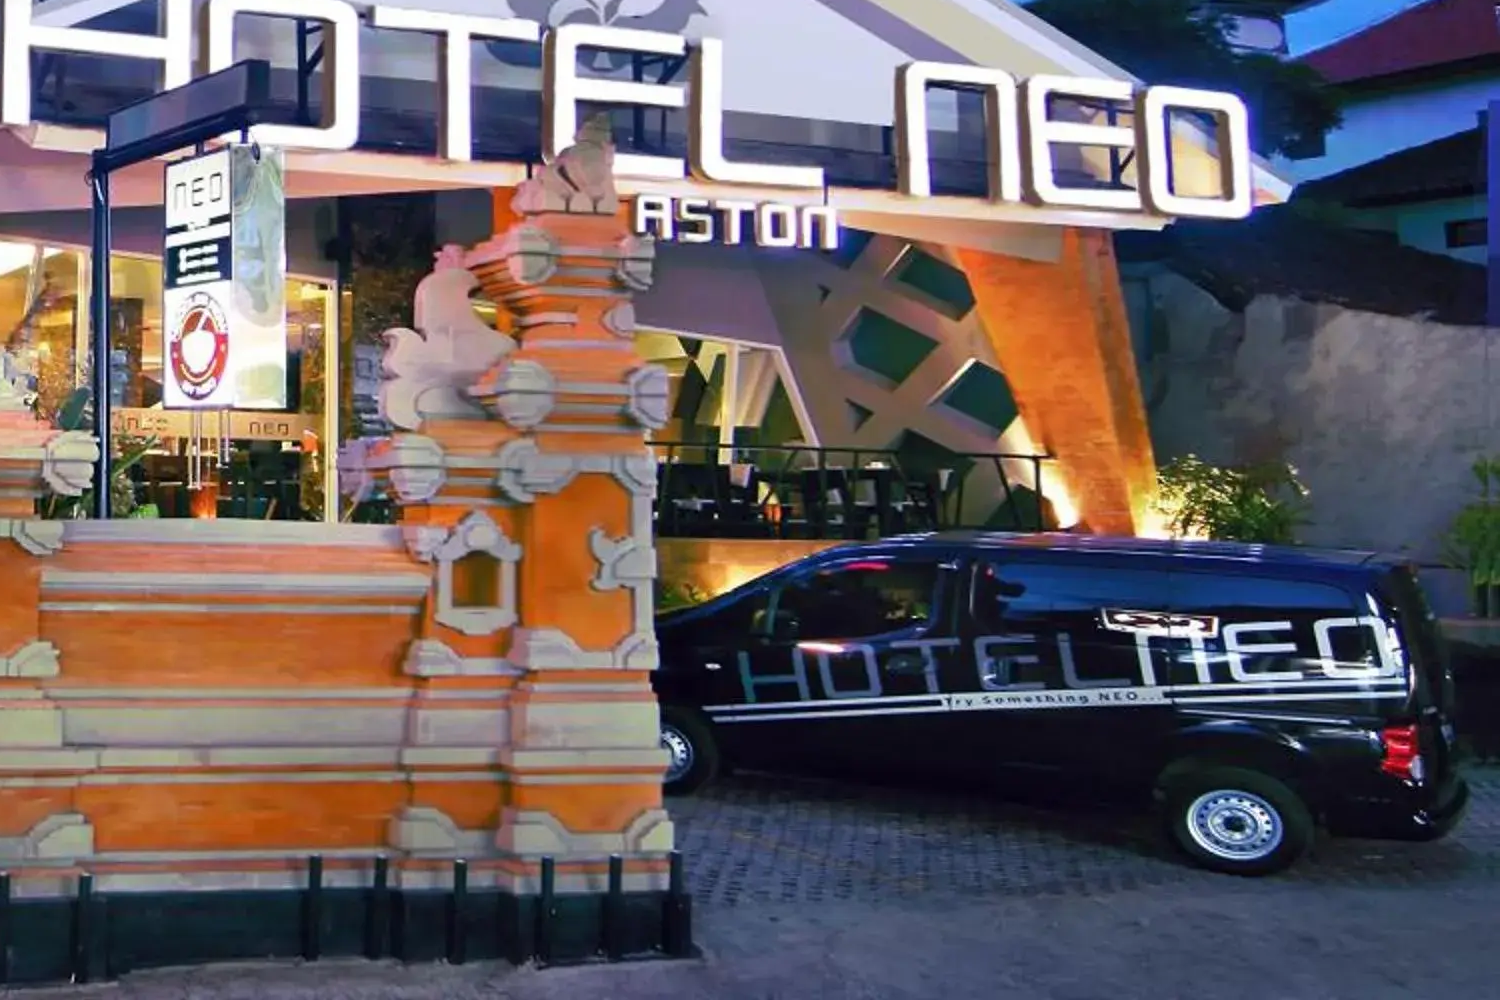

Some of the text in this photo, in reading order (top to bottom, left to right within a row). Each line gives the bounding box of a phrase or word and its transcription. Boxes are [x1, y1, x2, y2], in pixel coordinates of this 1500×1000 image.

[637, 193, 838, 250] ASTON
[737, 632, 1132, 703] HOTEL
[944, 695, 973, 707] Try
[981, 692, 1090, 705] Something
